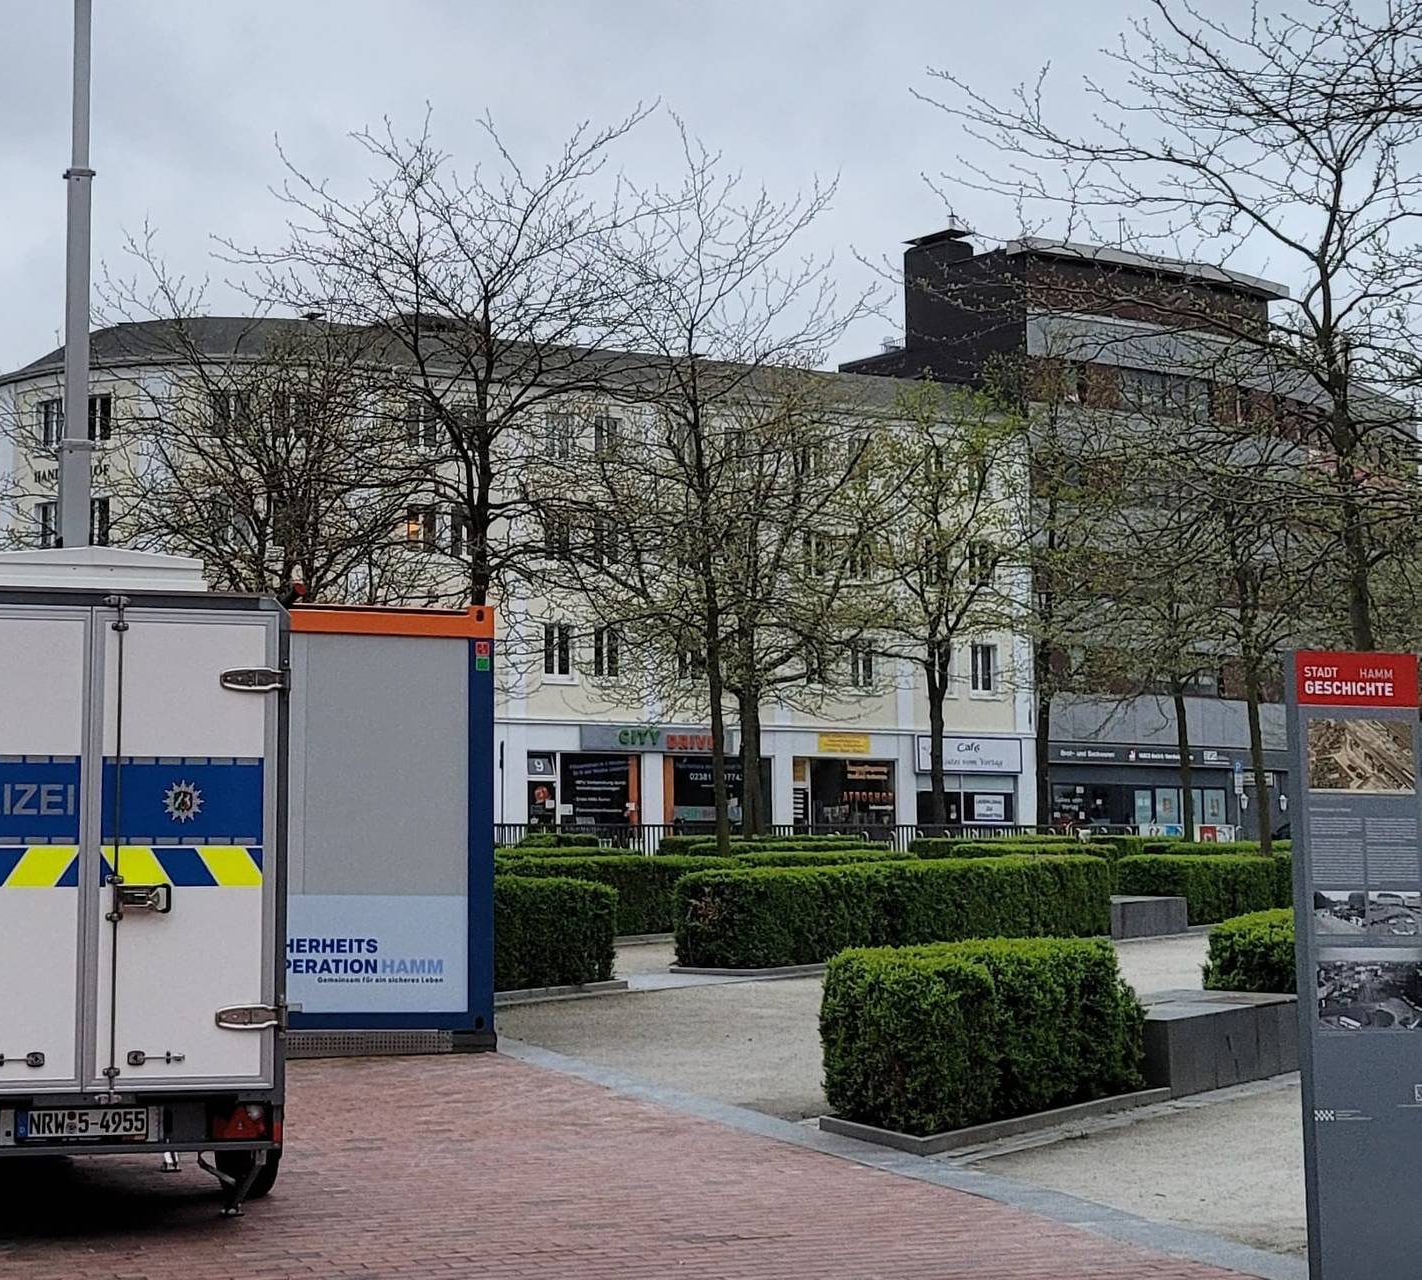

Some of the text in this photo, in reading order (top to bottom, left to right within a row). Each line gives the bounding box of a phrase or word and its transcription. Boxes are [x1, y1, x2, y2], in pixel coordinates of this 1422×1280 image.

[1304, 666, 1393, 679] STADT HAMM
[1305, 681, 1393, 696] GESCHICHTE
[619, 729, 660, 745] CITY
[534, 759, 544, 772] 9
[382, 959, 444, 974] HAMM
[317, 976, 360, 984] Gemeinsam
[30, 1112, 66, 1134] NRW
[79, 1110, 145, 1133] 5-4955
